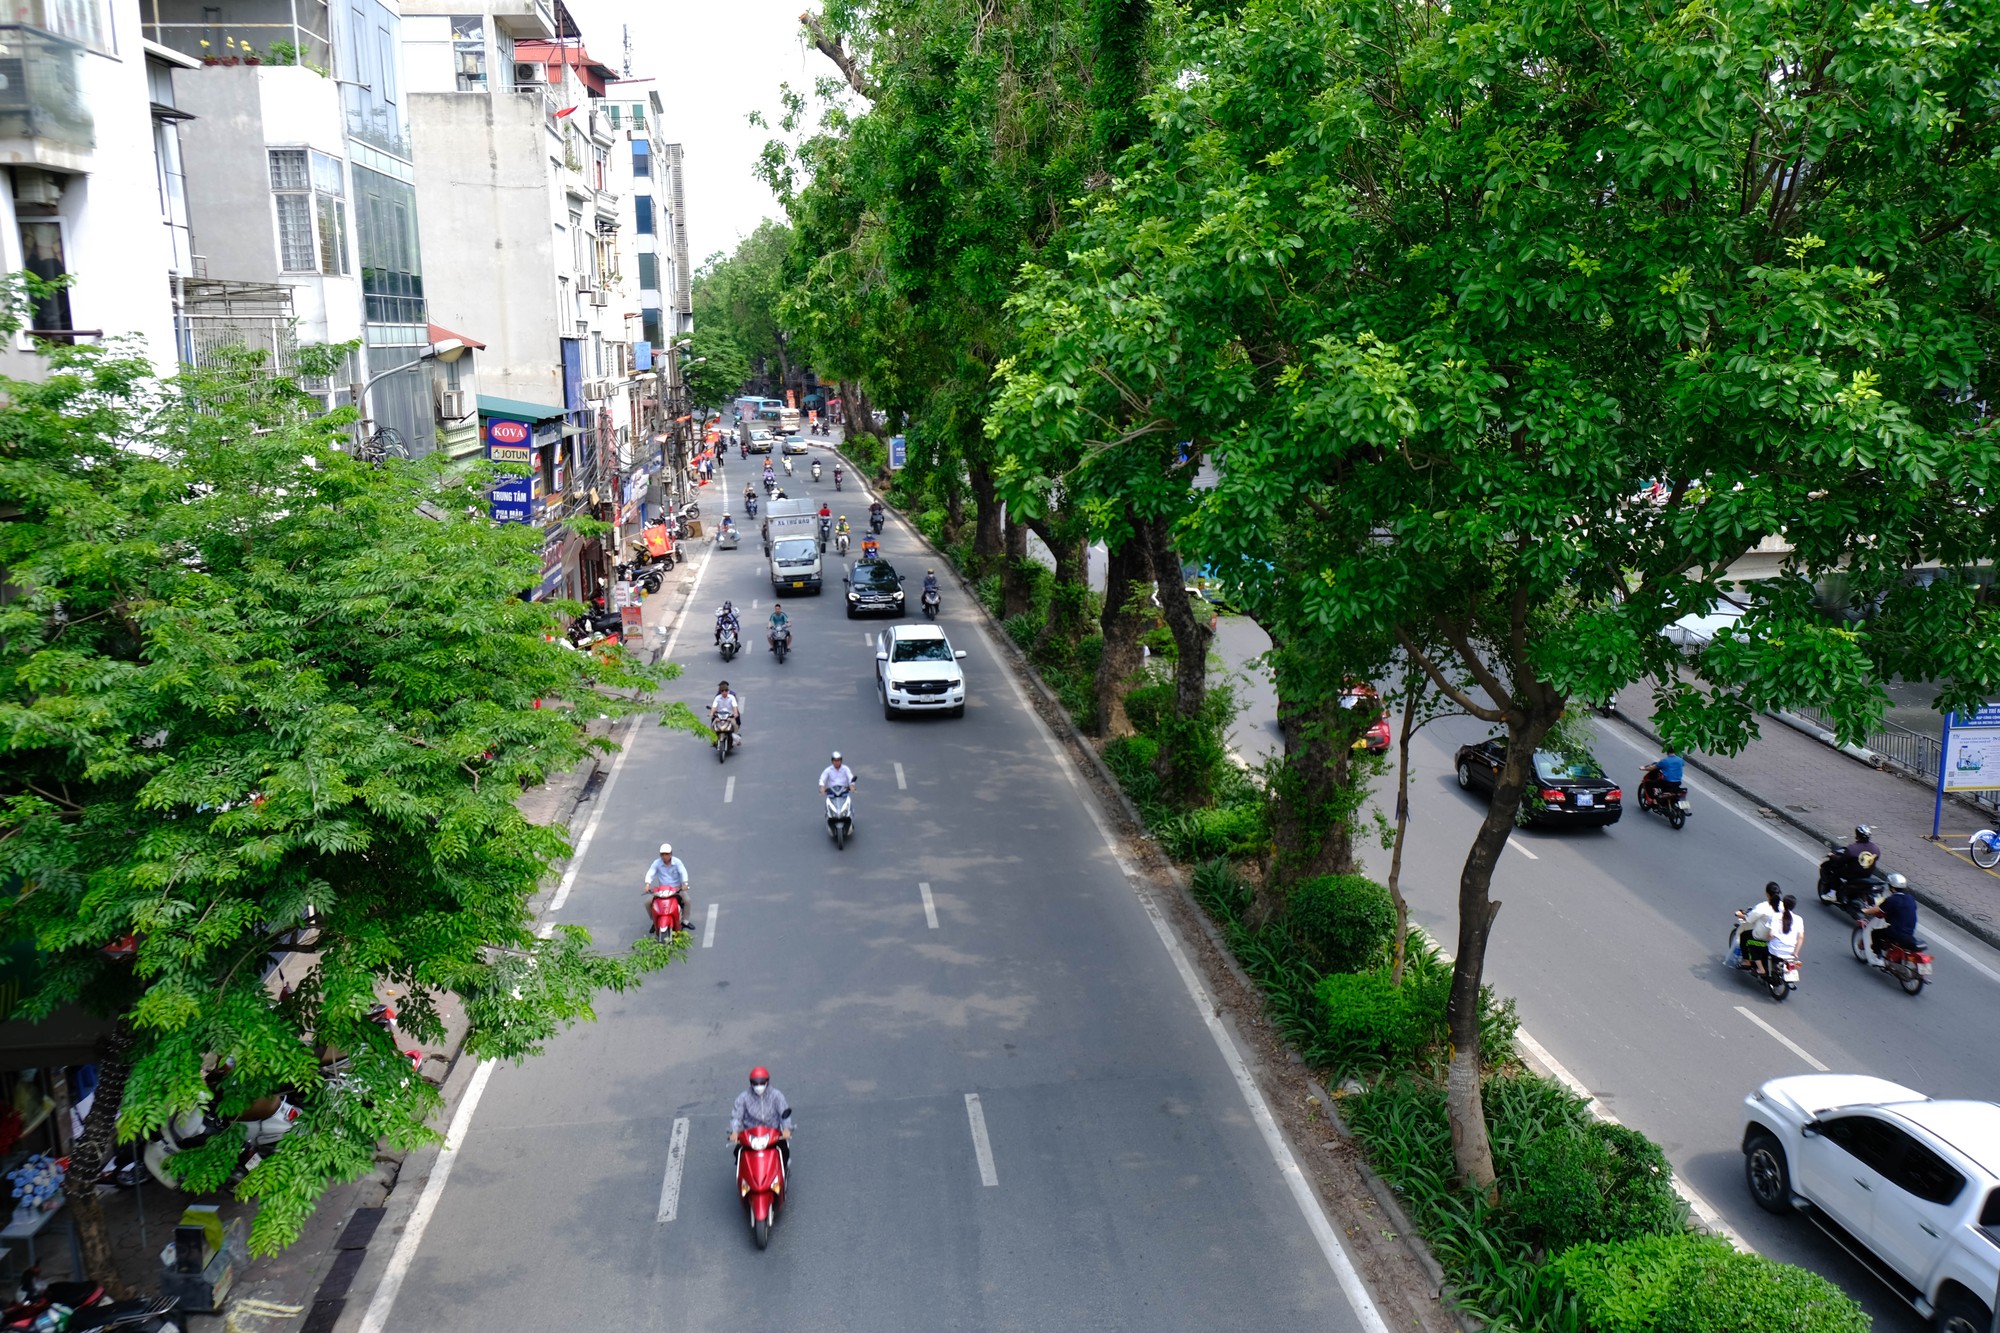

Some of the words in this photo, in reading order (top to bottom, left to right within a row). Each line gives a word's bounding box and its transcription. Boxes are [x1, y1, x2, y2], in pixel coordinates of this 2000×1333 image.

[494, 427, 524, 438] KOVA
[501, 449, 528, 459] JOTUN
[492, 491, 513, 502] TRUNG
[513, 490, 527, 503] TÂM
